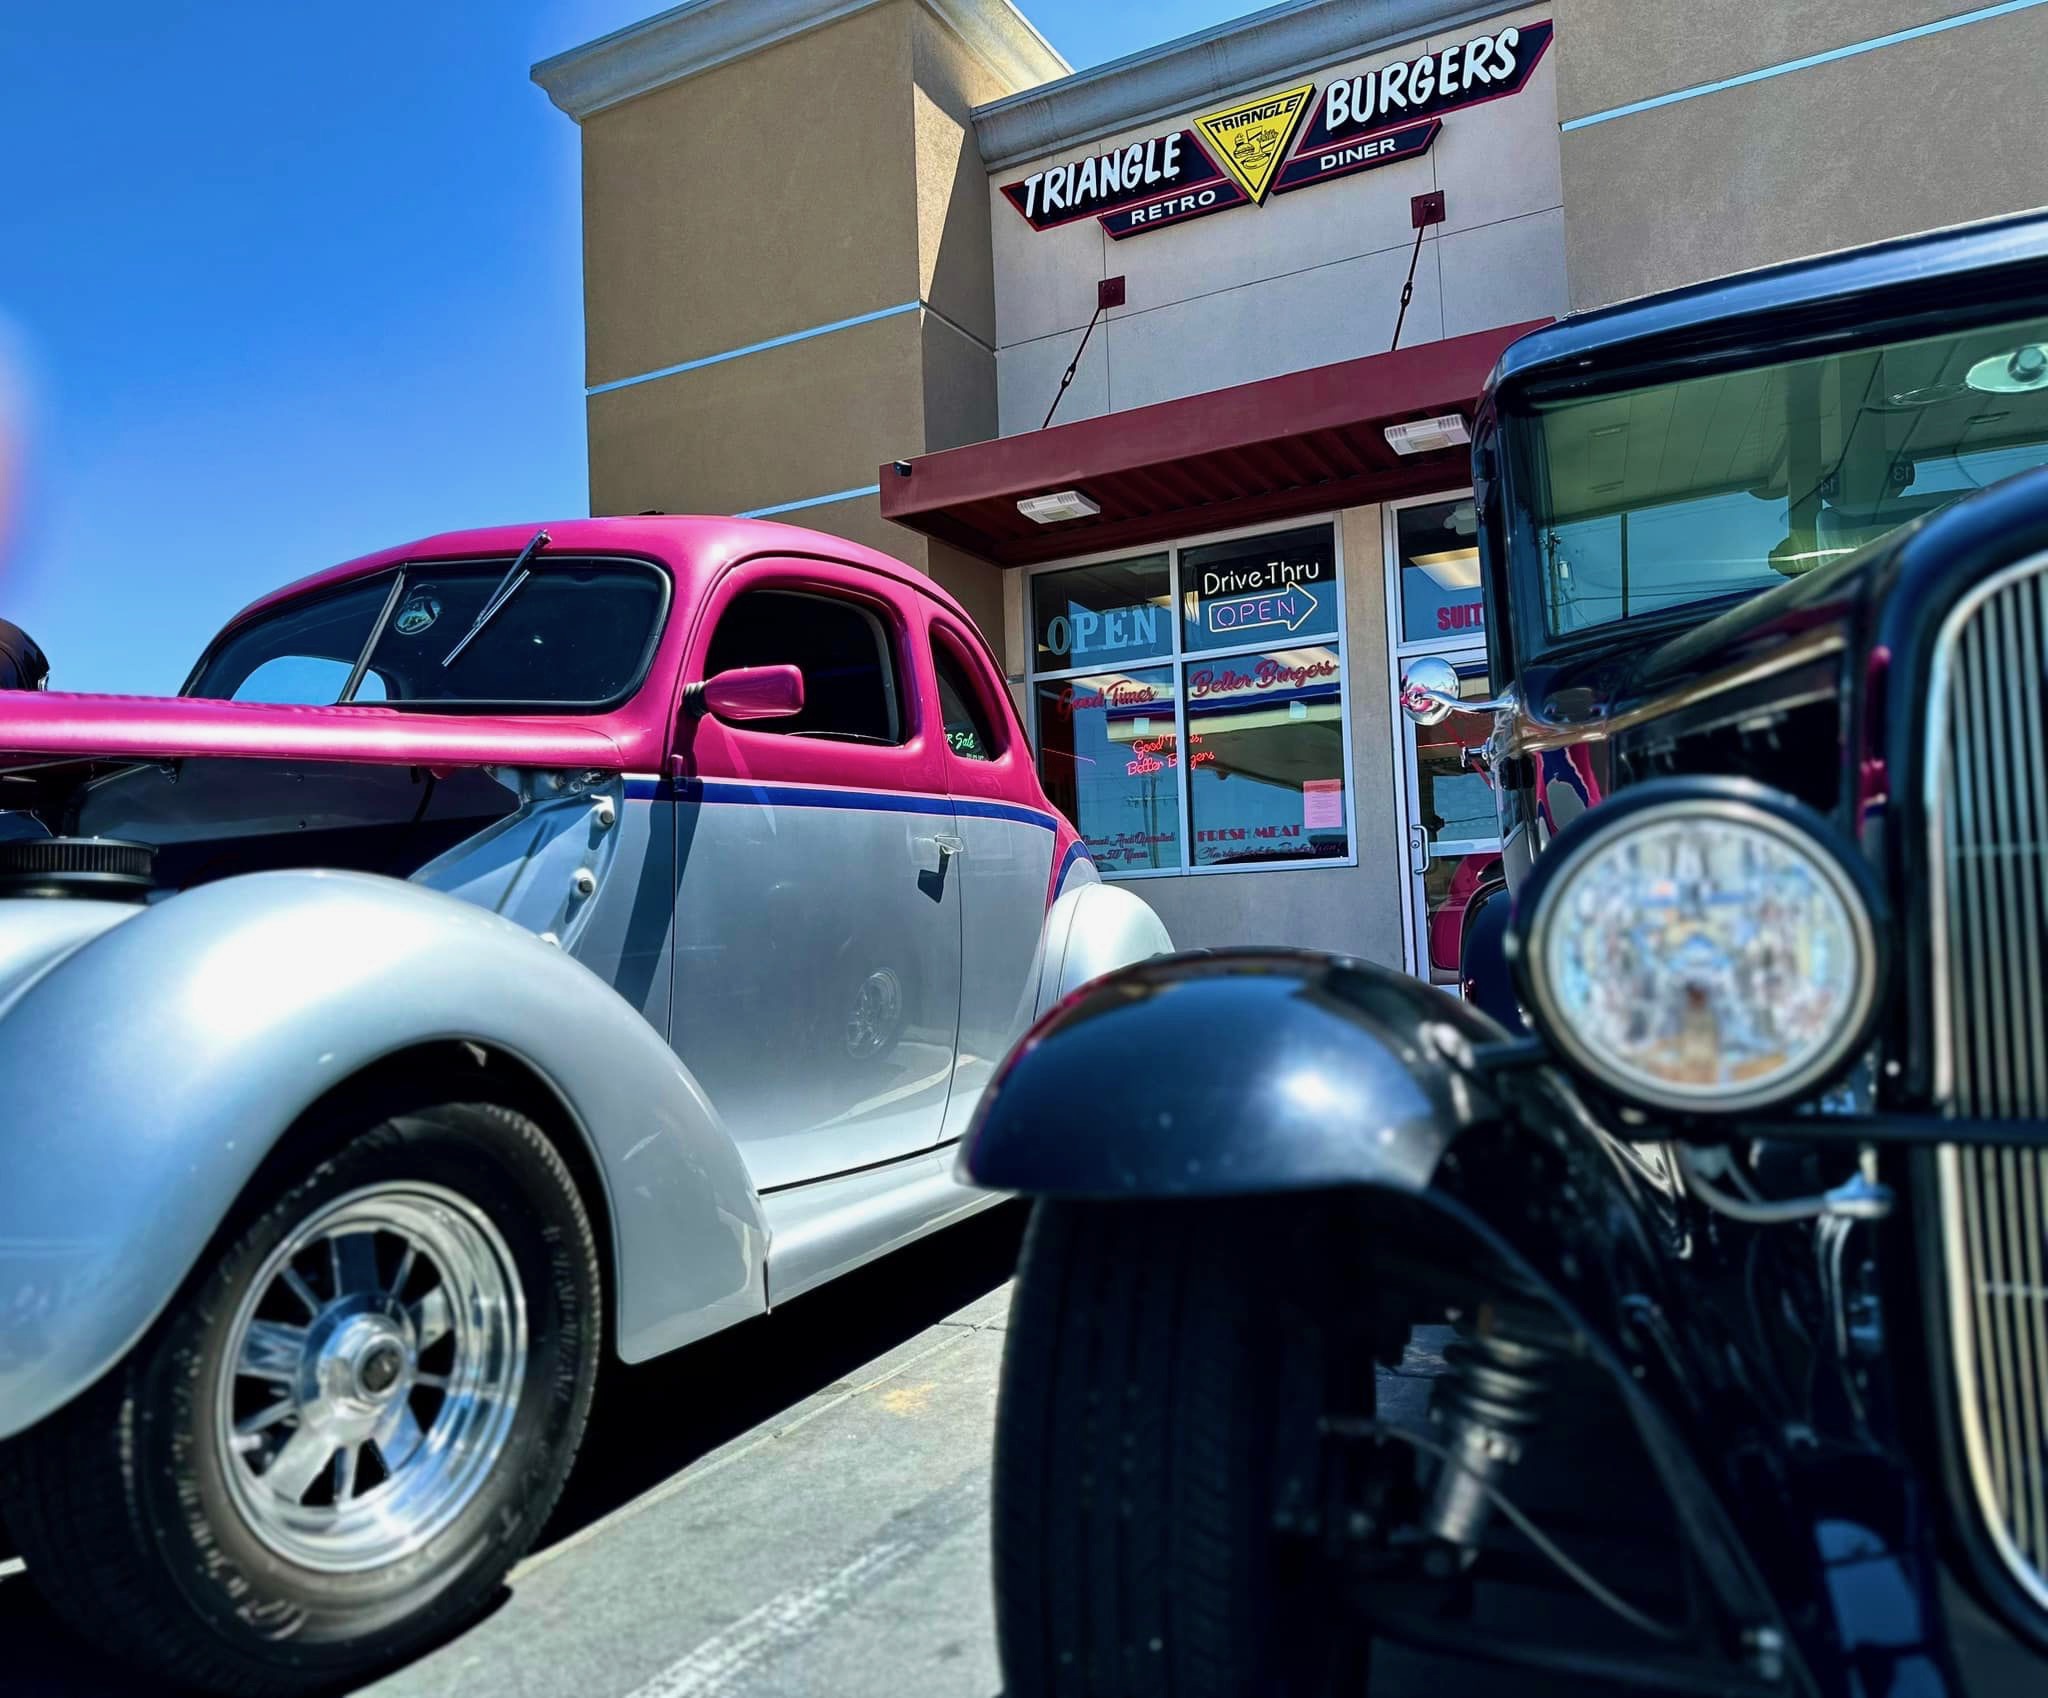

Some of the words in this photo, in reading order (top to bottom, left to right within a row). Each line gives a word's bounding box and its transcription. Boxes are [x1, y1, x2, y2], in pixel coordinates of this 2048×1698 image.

[1024, 131, 1182, 219] TRIANGLE
[1325, 25, 1520, 132] BURGERS
[1209, 98, 1298, 134] TRIANGLE
[1130, 189, 1217, 226] RETRO
[1320, 137, 1397, 172] DINER
[1203, 560, 1320, 596] Drive-Thru
[1216, 596, 1295, 627] OPEN
[1047, 604, 1157, 656] OPEN
[1104, 679, 1158, 707] Times
[1189, 668, 1253, 698] Better
[1254, 659, 1339, 690] Burgers
[1125, 757, 1164, 776] Better
[1166, 751, 1215, 771] Bgers
[1132, 734, 1165, 760] Good
